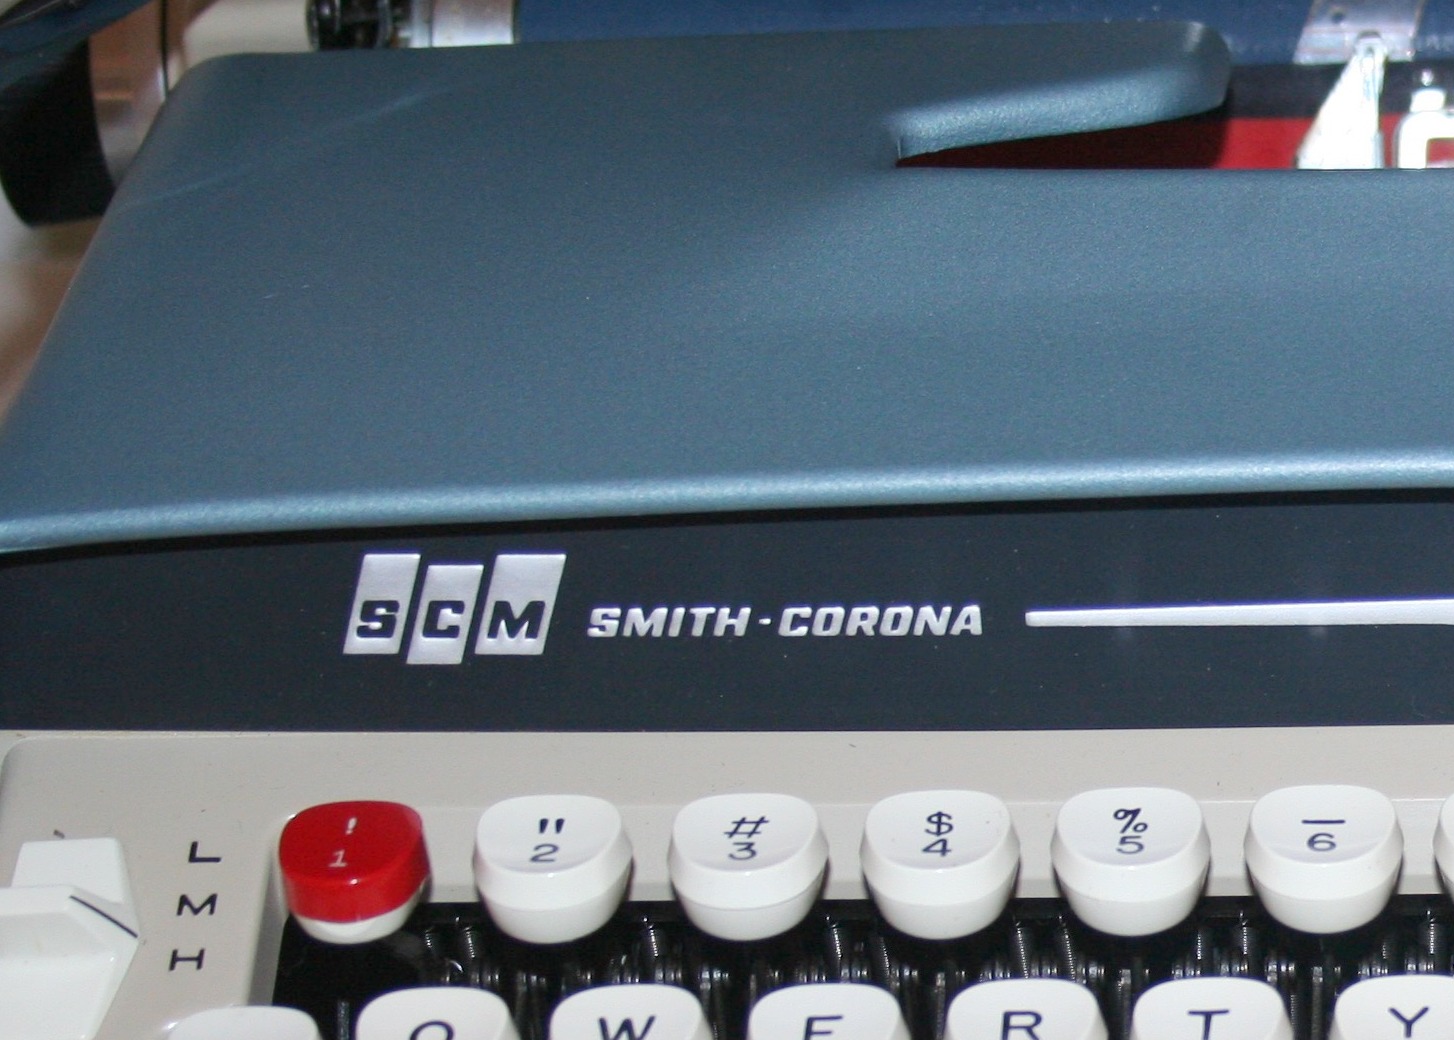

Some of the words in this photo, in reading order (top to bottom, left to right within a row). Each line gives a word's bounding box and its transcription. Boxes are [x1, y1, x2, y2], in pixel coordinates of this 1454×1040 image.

[345, 816, 358, 835] !
[724, 815, 770, 838] #
[924, 810, 955, 837] $
[1113, 807, 1149, 835] %
[188, 841, 221, 863] L
[728, 841, 758, 861] 3
[921, 837, 952, 857] 4
[1116, 835, 1146, 856] 5
[1306, 832, 1337, 852] 6
[328, 849, 348, 868] 1
[529, 843, 560, 863] 2
[176, 893, 218, 916] M
[169, 948, 205, 971] H
[1389, 1006, 1429, 1039] Y
